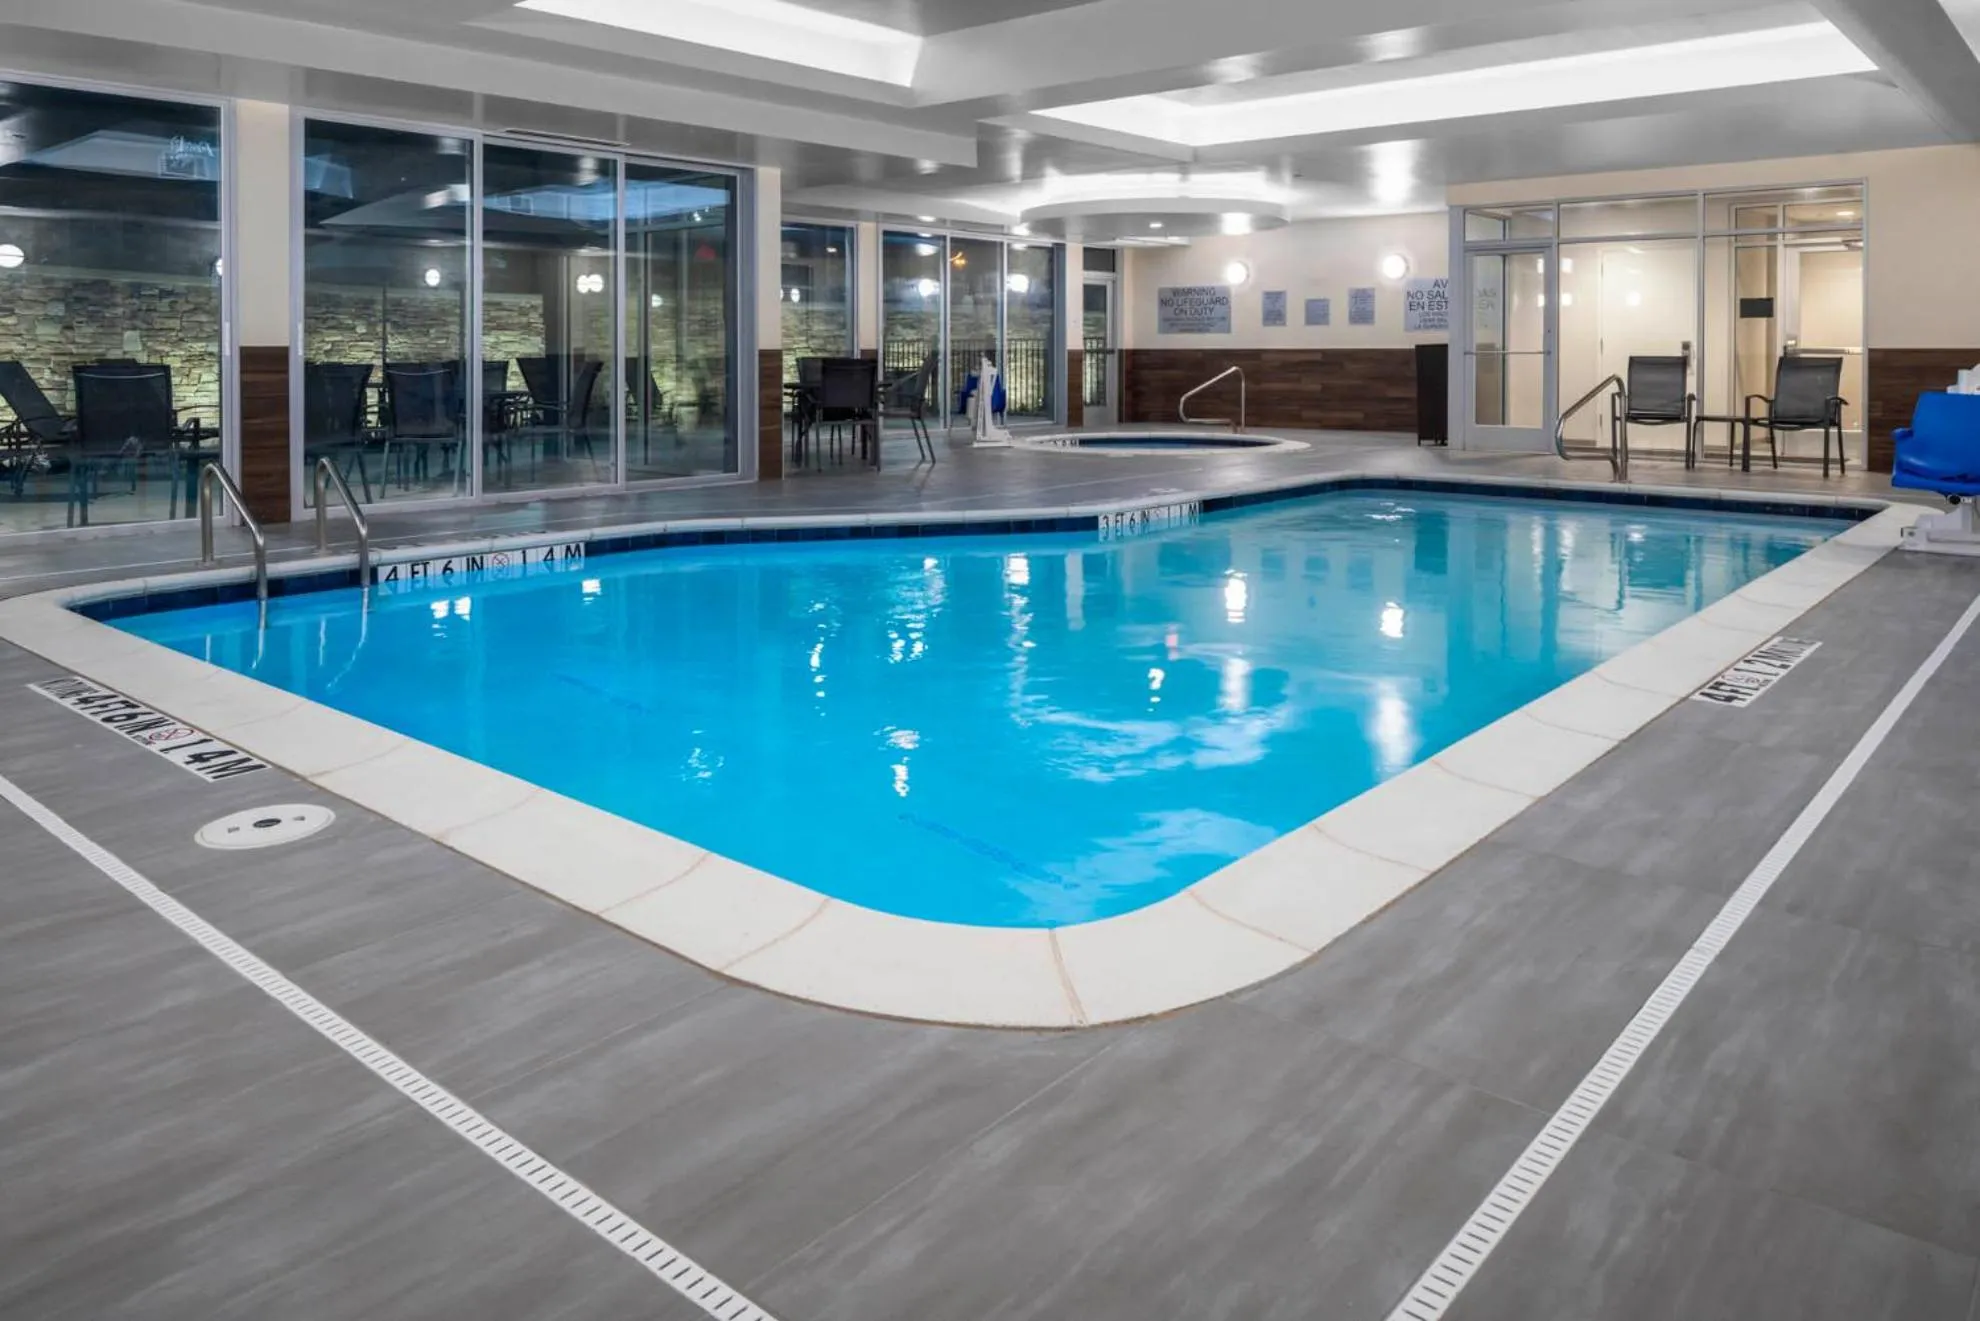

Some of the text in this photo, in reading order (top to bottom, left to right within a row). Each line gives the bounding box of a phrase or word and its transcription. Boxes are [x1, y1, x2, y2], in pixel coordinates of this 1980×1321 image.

[1171, 286, 1216, 297] WARNING
[1406, 290, 1424, 300] NO
[1160, 296, 1229, 307] NO LIFEGUARD
[1409, 300, 1425, 311] EN
[1173, 305, 1214, 316] ON DUTY
